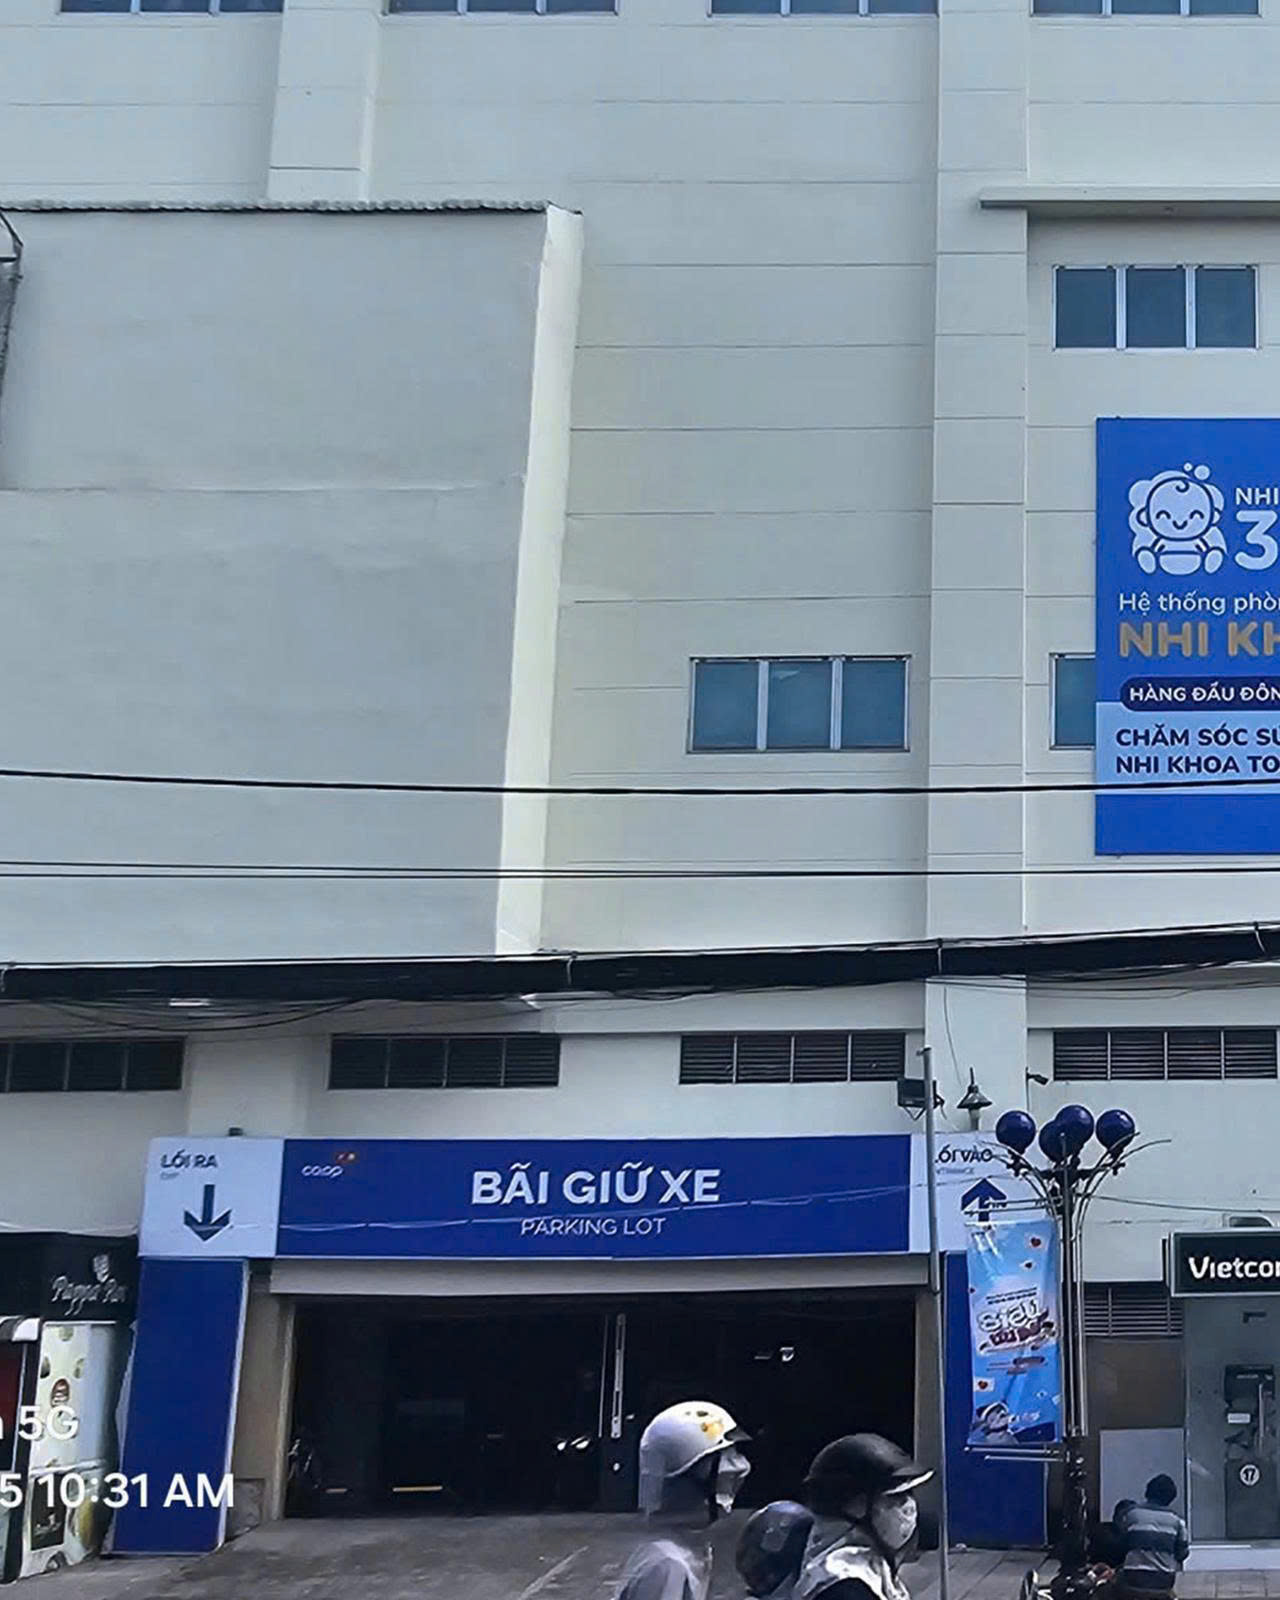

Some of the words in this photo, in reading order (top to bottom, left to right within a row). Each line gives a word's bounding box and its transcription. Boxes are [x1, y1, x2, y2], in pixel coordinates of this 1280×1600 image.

[1235, 486, 1280, 505] NHI
[1119, 593, 1151, 616] Hệ
[1158, 591, 1225, 616] thống
[1119, 620, 1208, 658] NHI
[1130, 683, 1187, 701] HÀNG
[1116, 723, 1190, 746] CHĂM
[1198, 721, 1248, 746] SÓC
[1116, 755, 1159, 773] NHI
[1168, 755, 1240, 773] KHOA
[193, 1154, 218, 1168] RA
[935, 1144, 957, 1164] ỐI
[471, 1161, 550, 1205] BÃI
[562, 1160, 655, 1204] GIỮ
[658, 1169, 721, 1203] XE
[520, 1218, 617, 1235] PARKING
[623, 1217, 666, 1235] LOT
